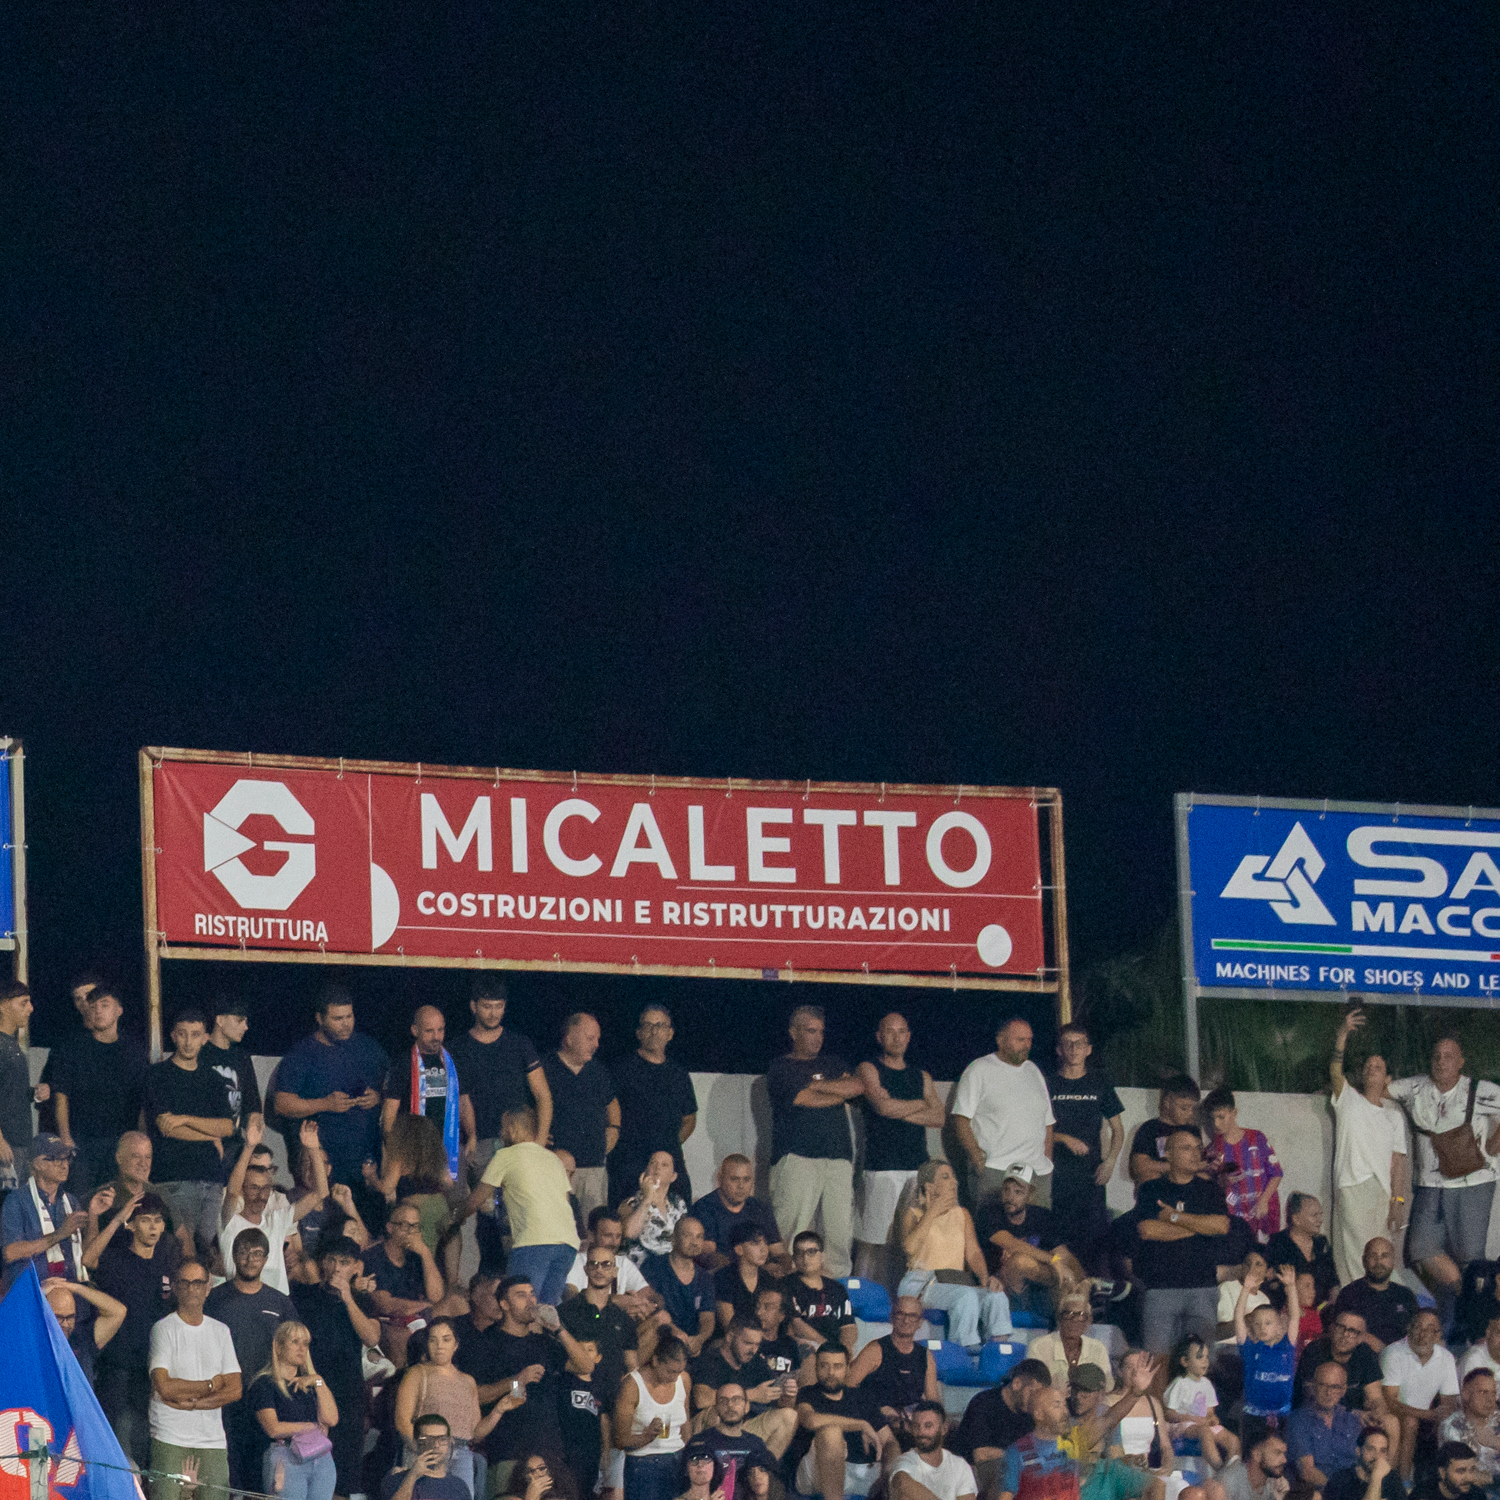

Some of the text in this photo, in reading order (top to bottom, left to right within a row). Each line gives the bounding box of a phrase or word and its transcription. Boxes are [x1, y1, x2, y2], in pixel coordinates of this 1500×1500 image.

[420, 793, 992, 888] MICALETTO
[194, 913, 329, 943] RISTRUTTURA
[418, 890, 951, 932] COSTRUZIONI E RISTRUTTURAZIONI
[1216, 962, 1310, 984] MACHINES
[1319, 965, 1355, 986] FOR
[1364, 967, 1424, 987] SHOES
[1432, 969, 1470, 989] AND
